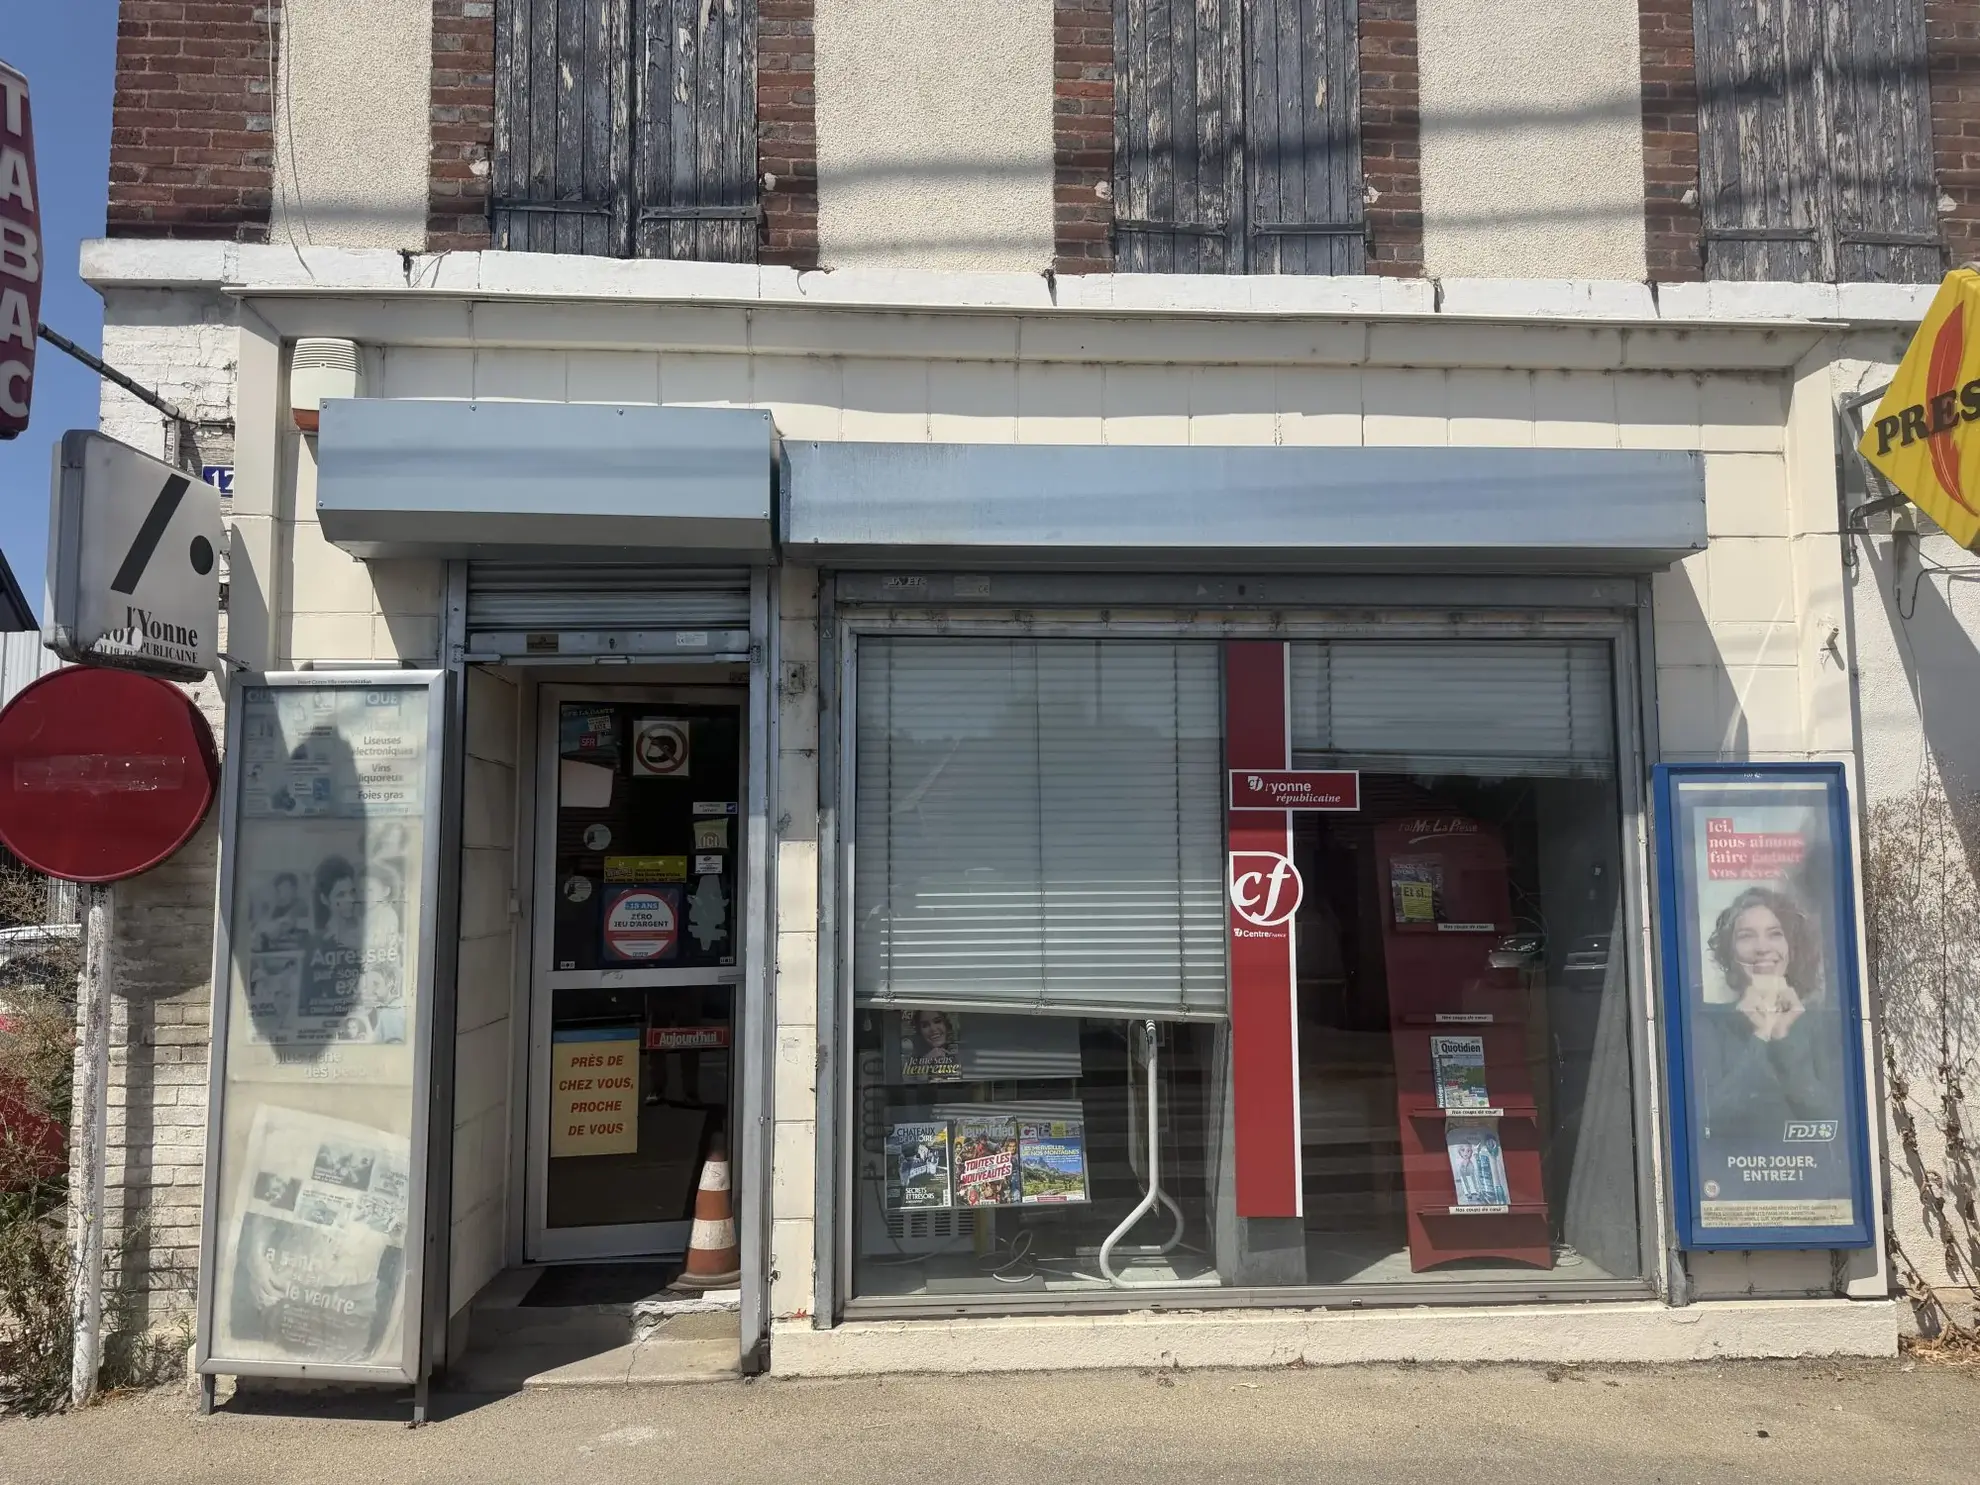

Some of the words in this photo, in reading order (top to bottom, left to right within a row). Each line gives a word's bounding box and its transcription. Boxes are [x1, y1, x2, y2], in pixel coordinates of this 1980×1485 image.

[0, 78, 39, 419] TABAC
[1874, 379, 1980, 456] PRES
[212, 470, 235, 491] 17
[127, 605, 198, 648] l'Yonne
[134, 643, 198, 664] PUBLICAINE
[364, 735, 402, 745] Liseuses
[372, 762, 391, 772] Vins
[357, 790, 381, 800] Foies
[384, 791, 404, 802] gras
[1276, 793, 1341, 805] républicaine
[1708, 820, 1732, 833] Ici,
[1709, 838, 1745, 848] nous
[1710, 850, 1747, 863] faire
[1231, 859, 1291, 922] cf
[630, 920, 669, 928] D'ARGENT
[658, 1031, 717, 1049] Aujourd'hui
[1441, 1043, 1481, 1054] Quotidien
[571, 1053, 604, 1068] PRÈS
[607, 1055, 624, 1066] DE
[902, 1062, 960, 1076] heureuse
[558, 1079, 592, 1091] CHEZ
[597, 1077, 634, 1090] VOUS,
[570, 1100, 622, 1113] PROCHE
[568, 1124, 585, 1136] DE
[589, 1122, 624, 1135] VOUS
[1787, 1124, 1816, 1138] FDJ
[966, 1156, 995, 1172] TOUTES
[996, 1153, 1011, 1165] LES
[1727, 1156, 1767, 1168] POUR
[1768, 1156, 1817, 1169] JOUER,
[962, 1165, 1012, 1185] NOUVEAUTÉS
[1743, 1170, 1797, 1182] ENTREZ
[1798, 1170, 1804, 1181] !
